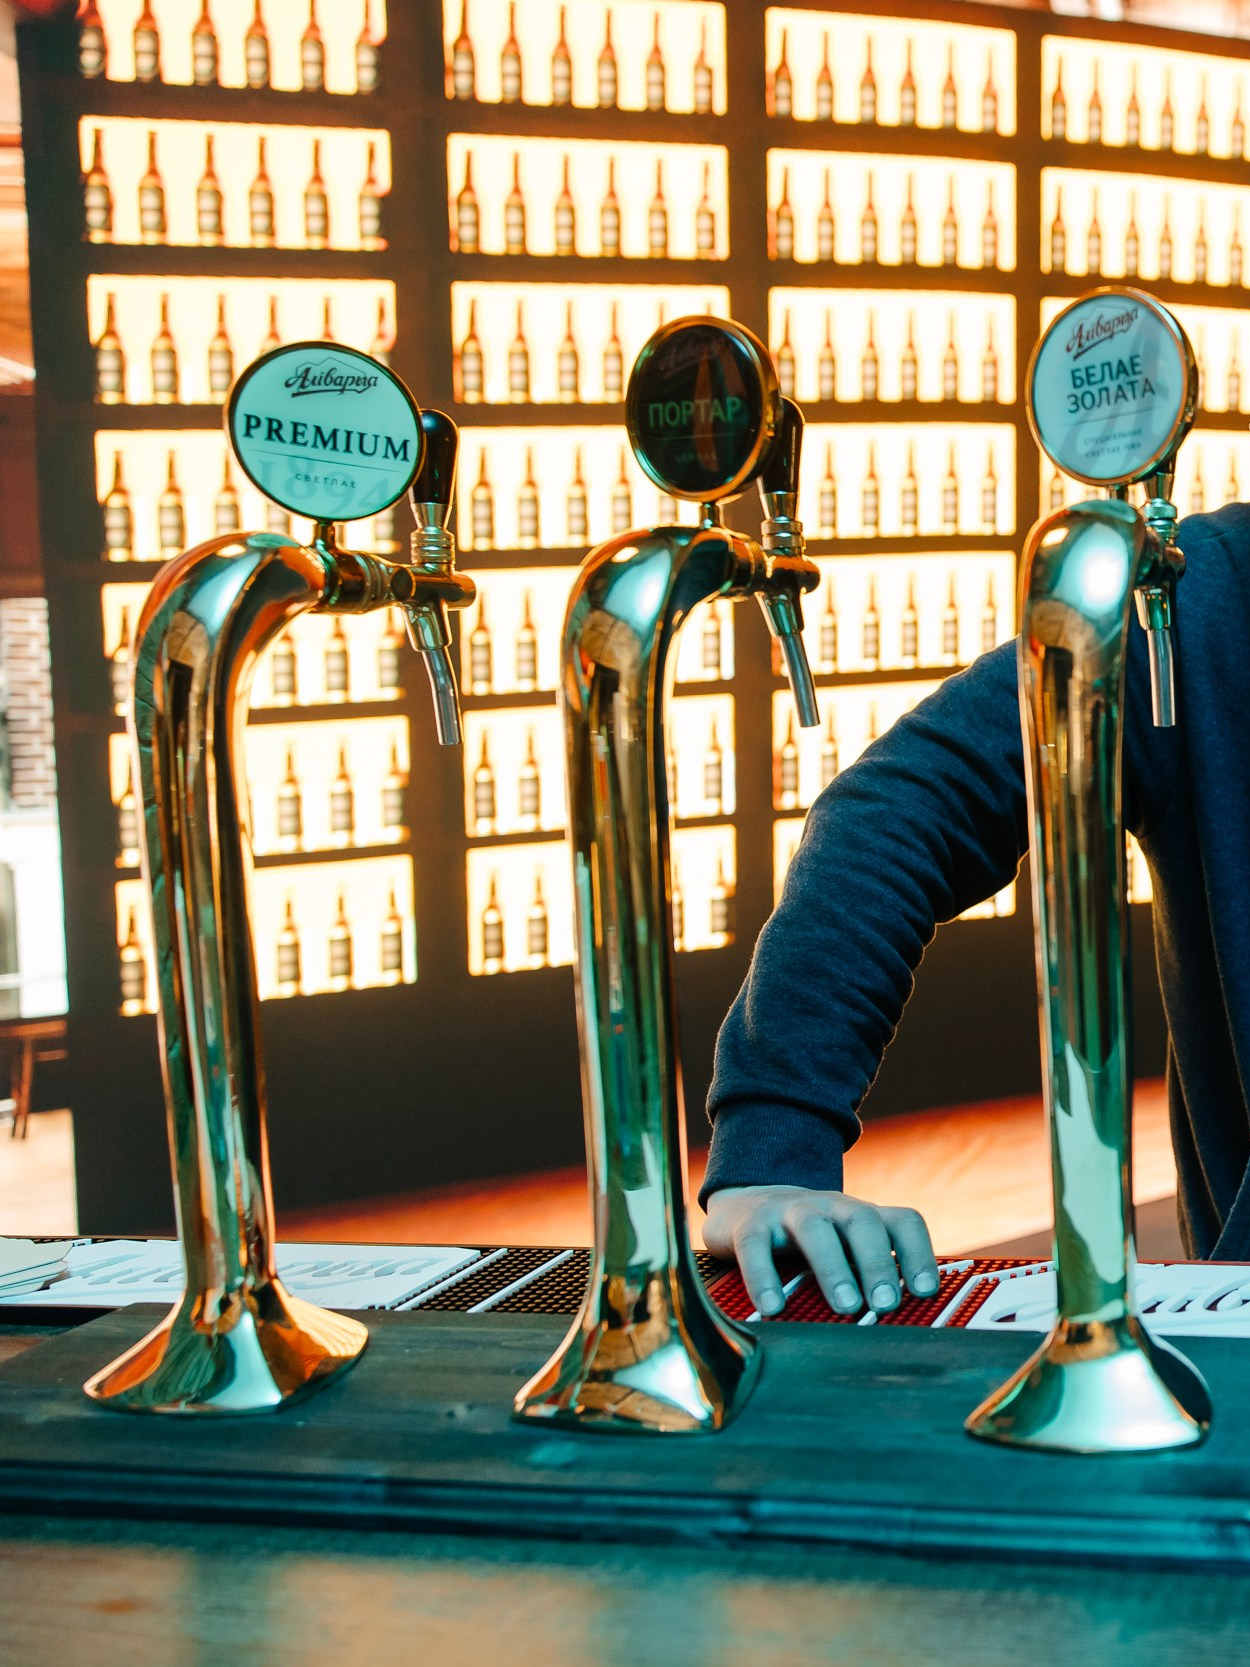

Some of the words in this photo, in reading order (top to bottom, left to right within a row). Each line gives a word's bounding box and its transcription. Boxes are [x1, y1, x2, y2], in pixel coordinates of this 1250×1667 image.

[1070, 354, 1143, 390] БЕЛАЕ
[649, 396, 742, 428] ПОРТАР
[1066, 377, 1156, 415] ЗОЛАТА
[242, 413, 411, 463] PREMIUM
[295, 473, 358, 489] СВЕТЛАЕ
